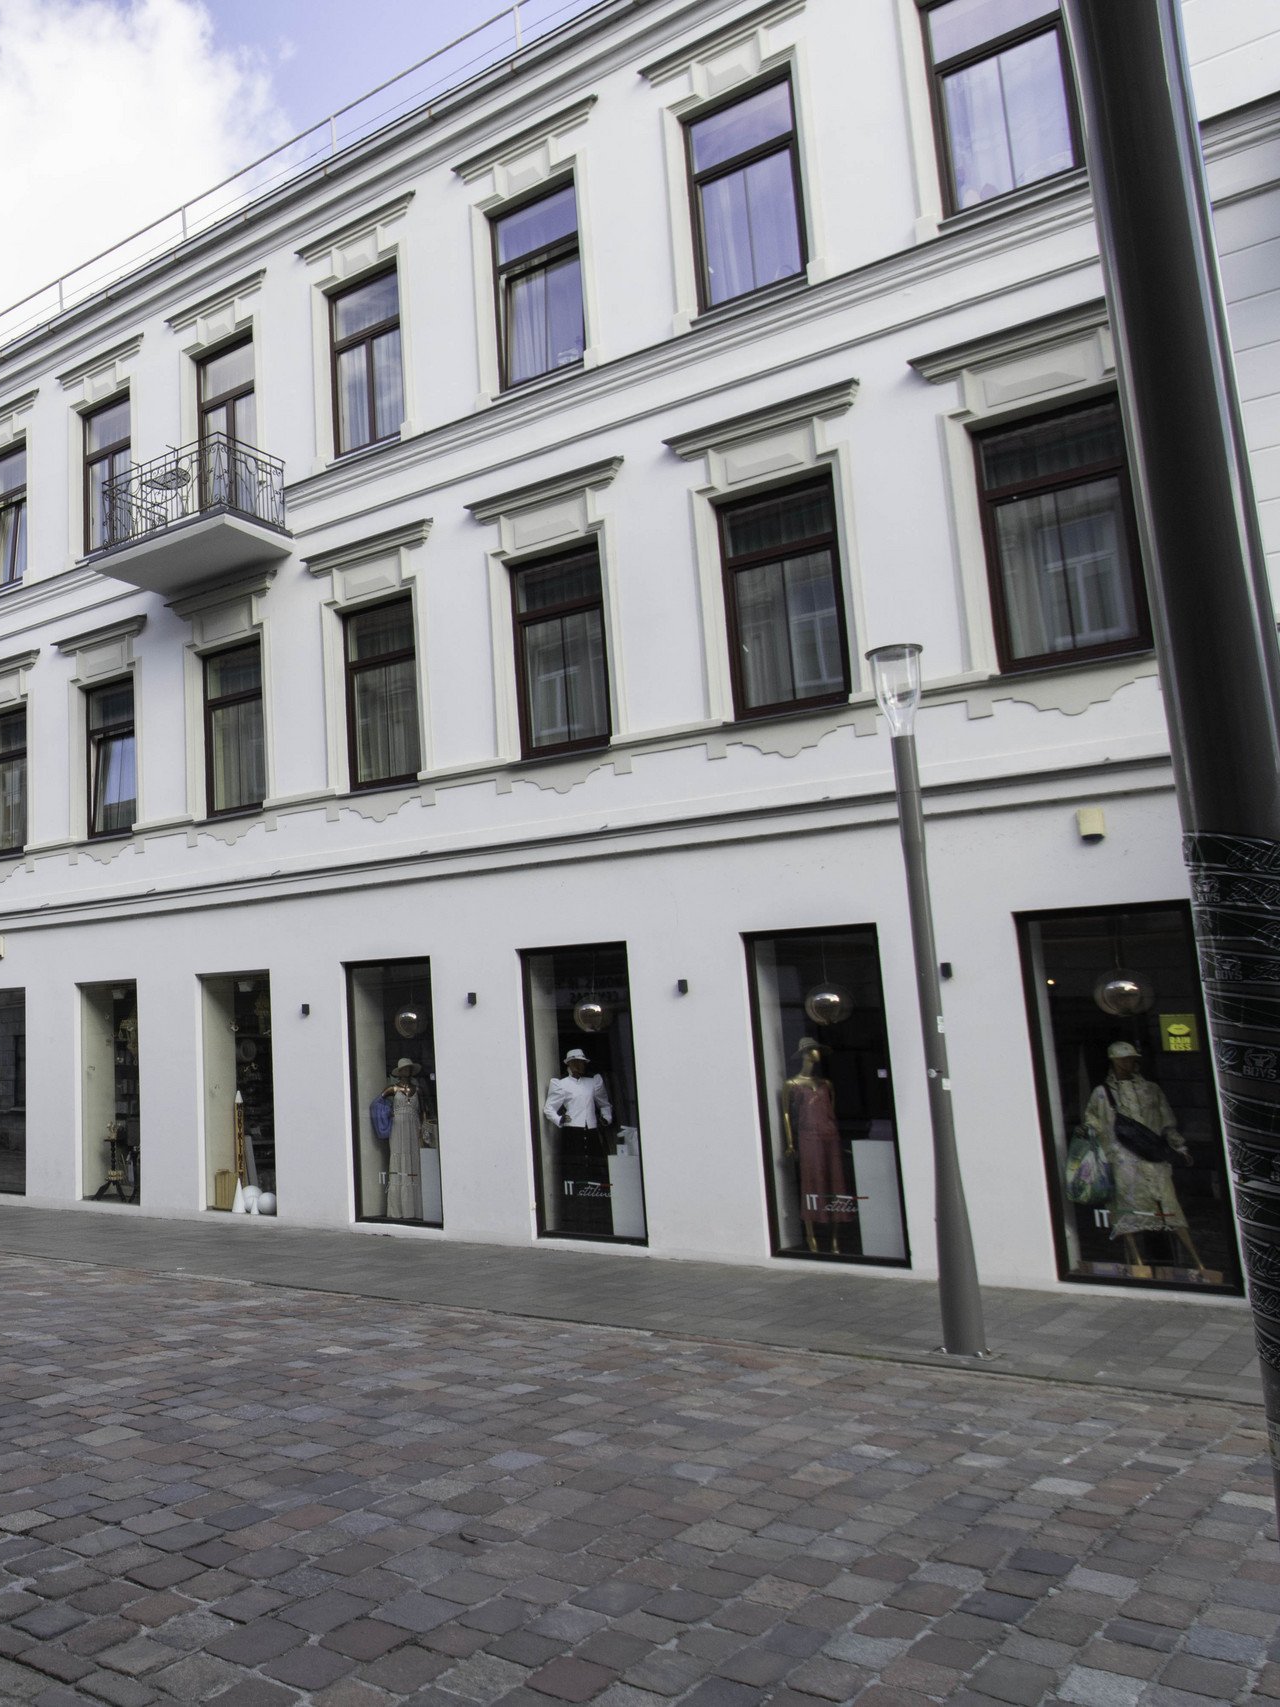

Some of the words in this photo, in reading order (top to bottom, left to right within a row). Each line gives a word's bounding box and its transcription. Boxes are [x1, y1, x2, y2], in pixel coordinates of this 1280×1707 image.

[1242, 1065, 1277, 1080] BOYS
[564, 1180, 575, 1196] IT
[806, 1193, 819, 1211] IT
[1093, 1208, 1111, 1229] IT
